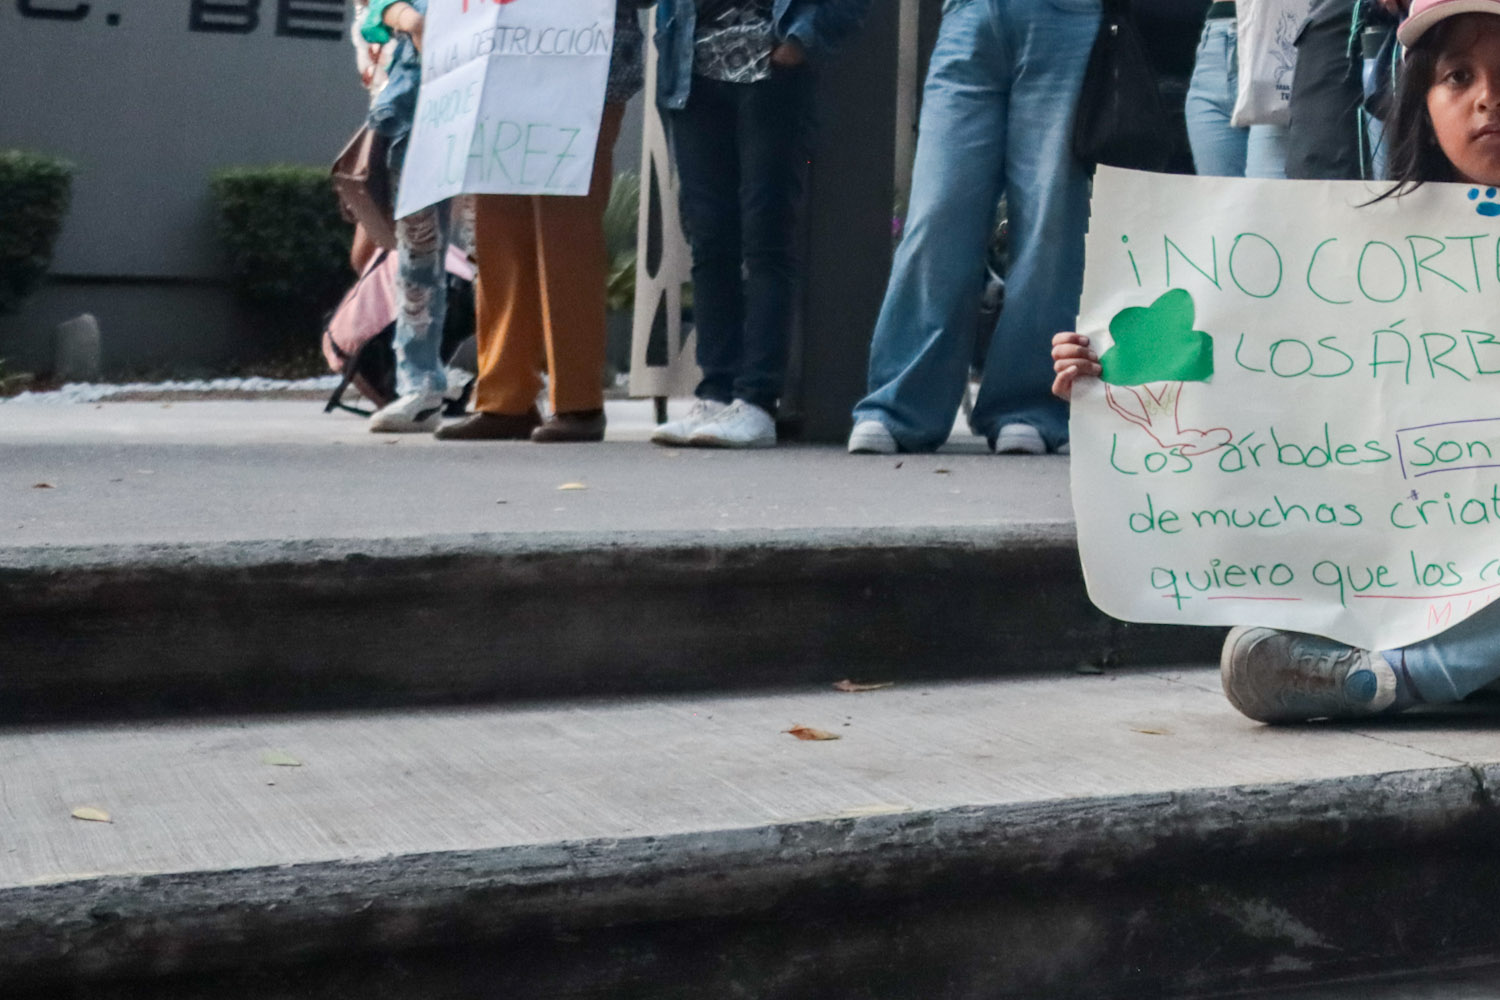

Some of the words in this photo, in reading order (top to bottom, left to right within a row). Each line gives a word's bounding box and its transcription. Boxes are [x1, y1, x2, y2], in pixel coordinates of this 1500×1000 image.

[1120, 232, 1283, 299] ¡NO
[1235, 329, 1355, 379] LOS
[1129, 492, 1184, 534] de
[1191, 495, 1363, 528] muchas
[1150, 558, 1294, 611] quiero
[1312, 560, 1399, 609] que
[1410, 549, 1463, 587] los
